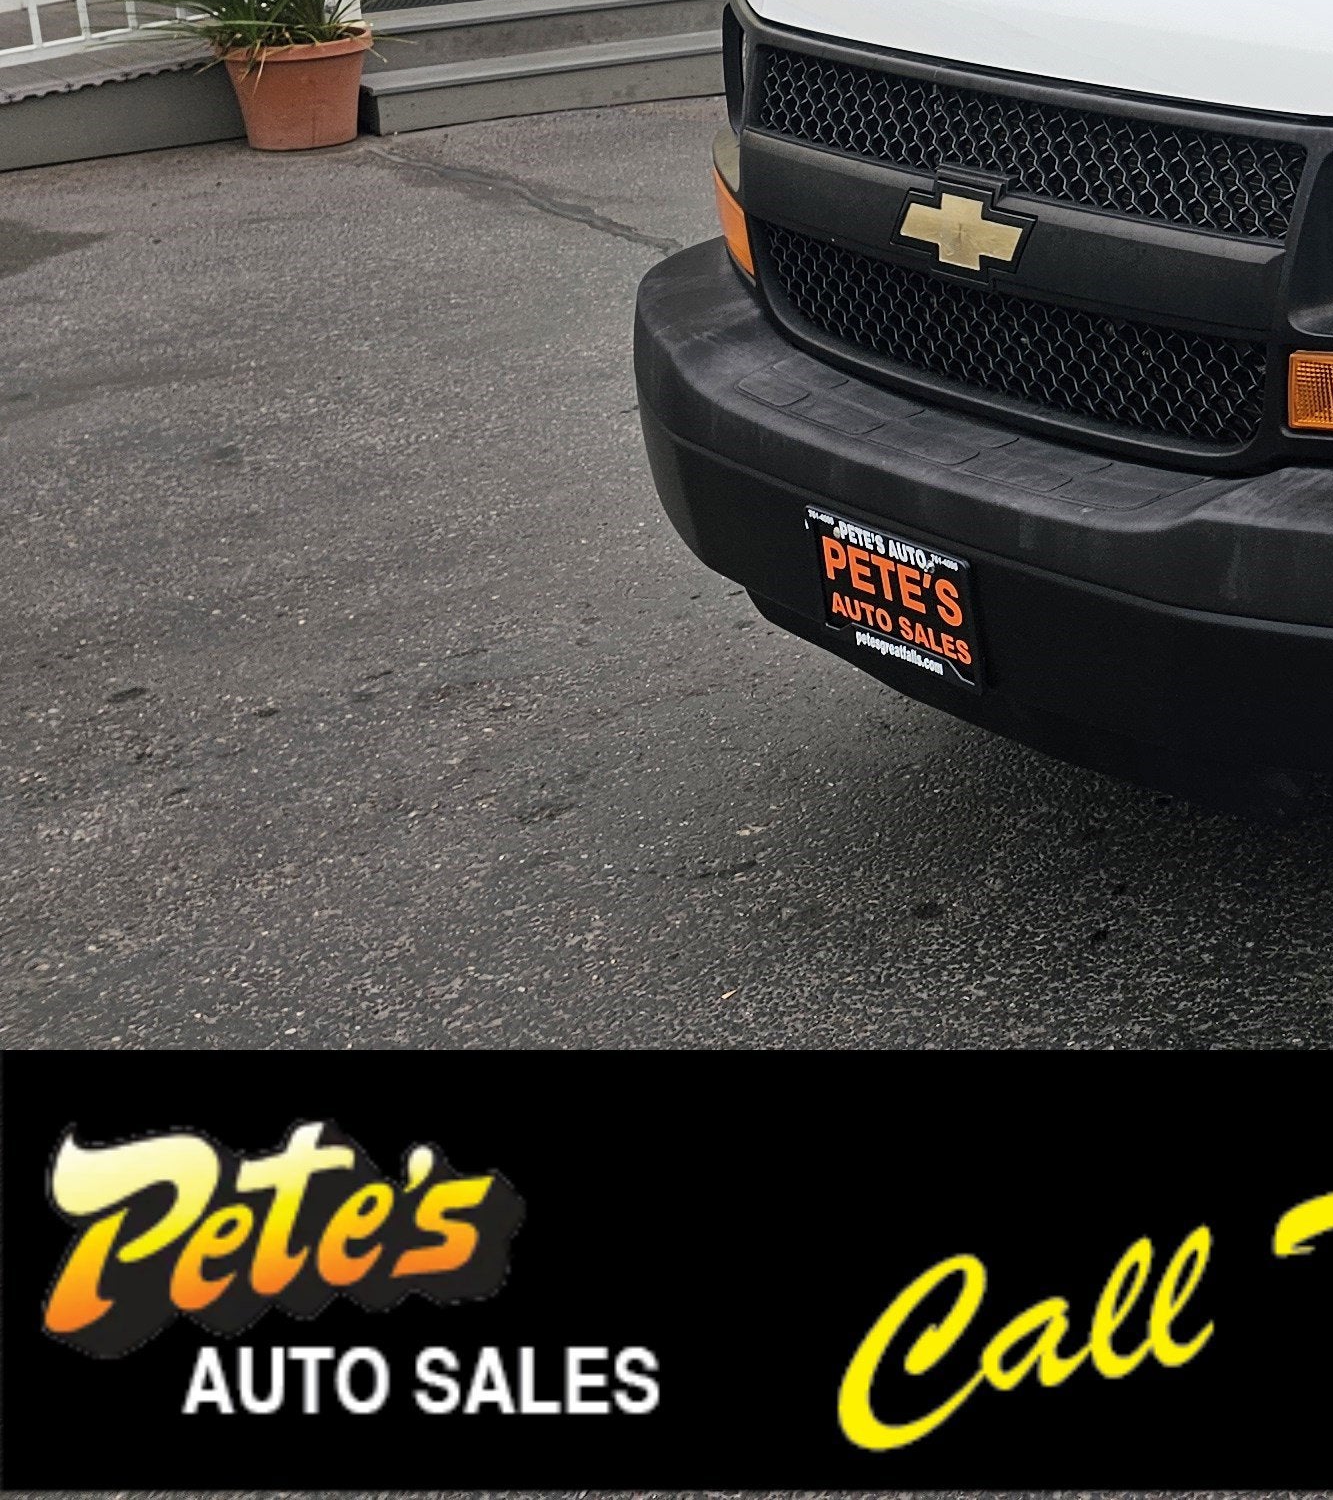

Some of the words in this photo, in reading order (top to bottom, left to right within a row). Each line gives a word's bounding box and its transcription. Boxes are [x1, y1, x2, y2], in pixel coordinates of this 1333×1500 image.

[838, 520, 886, 555] PETE'S
[889, 539, 927, 569] AUTO
[822, 536, 963, 627] PETE'S
[832, 592, 893, 633] AUTO
[898, 616, 972, 665] SALES
[856, 631, 944, 676] petesgreatfalls.com
